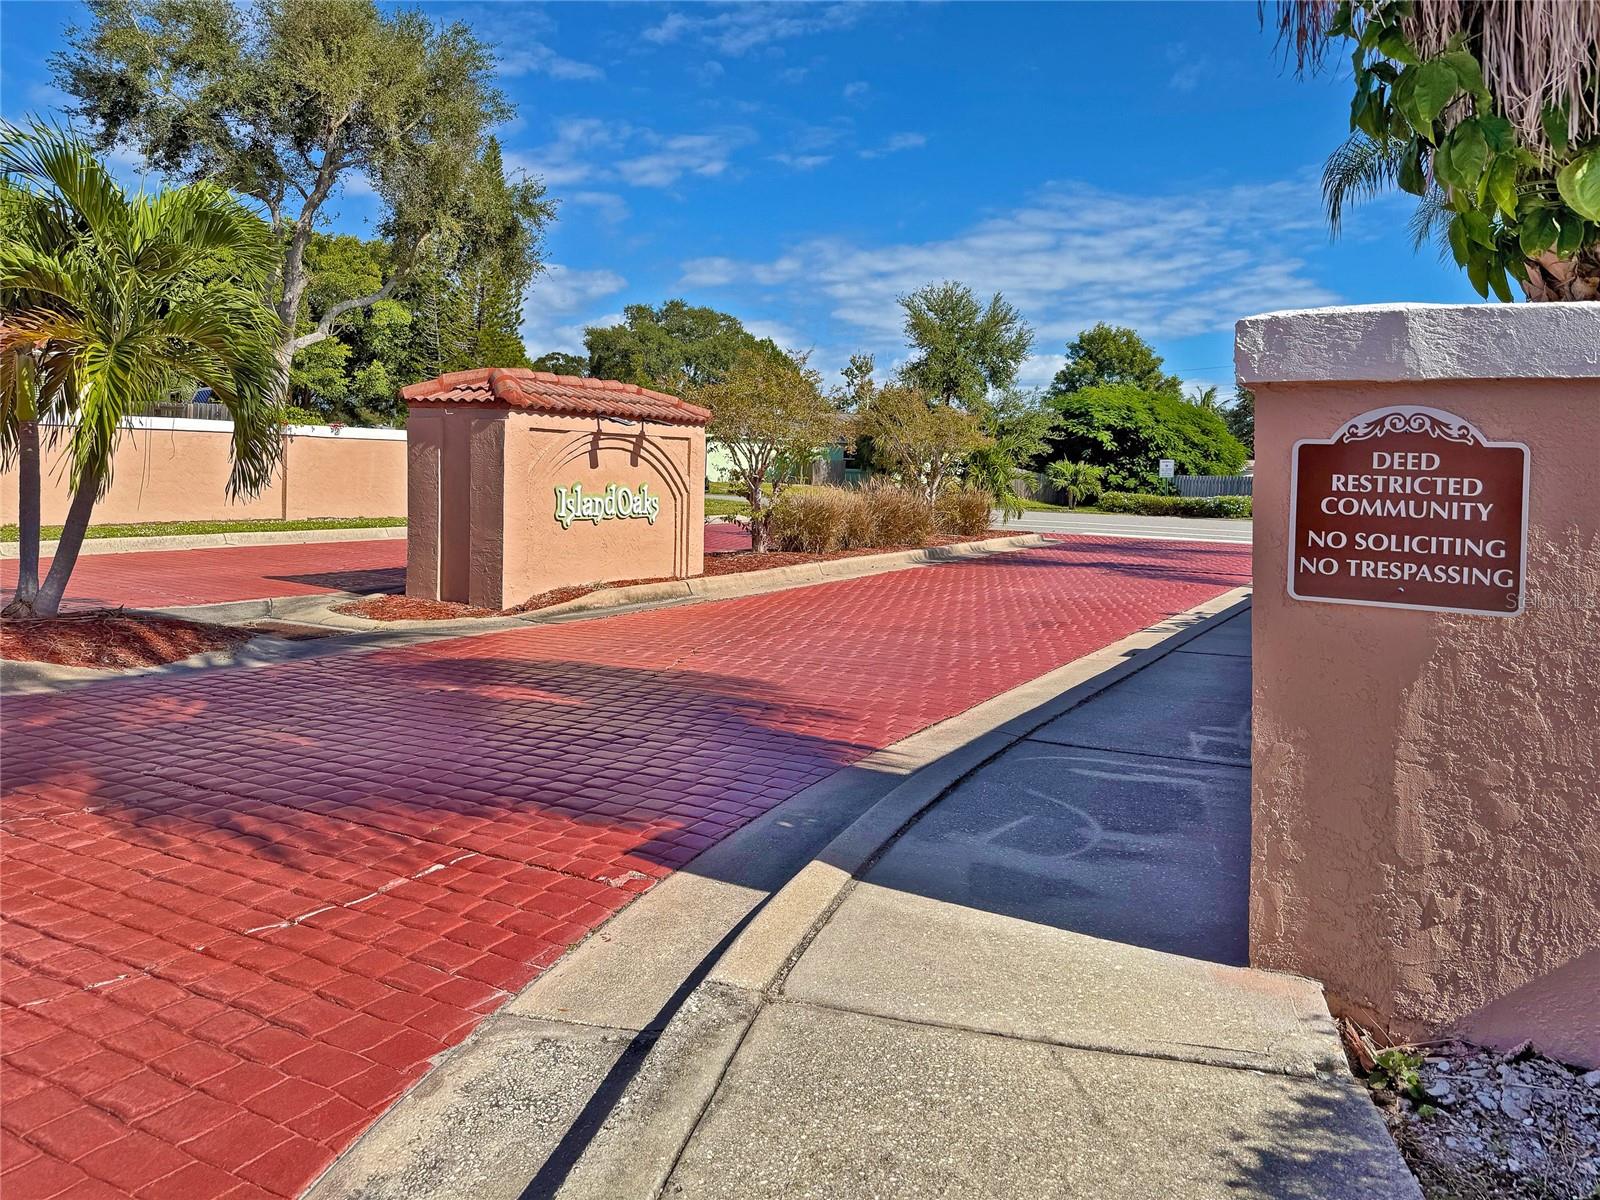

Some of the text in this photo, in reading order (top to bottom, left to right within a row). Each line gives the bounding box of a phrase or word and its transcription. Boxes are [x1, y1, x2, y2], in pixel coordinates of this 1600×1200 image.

[1372, 452, 1440, 470] DEED
[1332, 475, 1483, 496] RESTRICTED
[555, 481, 659, 529] Island Oaks
[1321, 497, 1493, 521] COMMUNITY
[1308, 531, 1506, 558] NO SOLICITING
[1300, 557, 1513, 588] NO TRESPASSING
